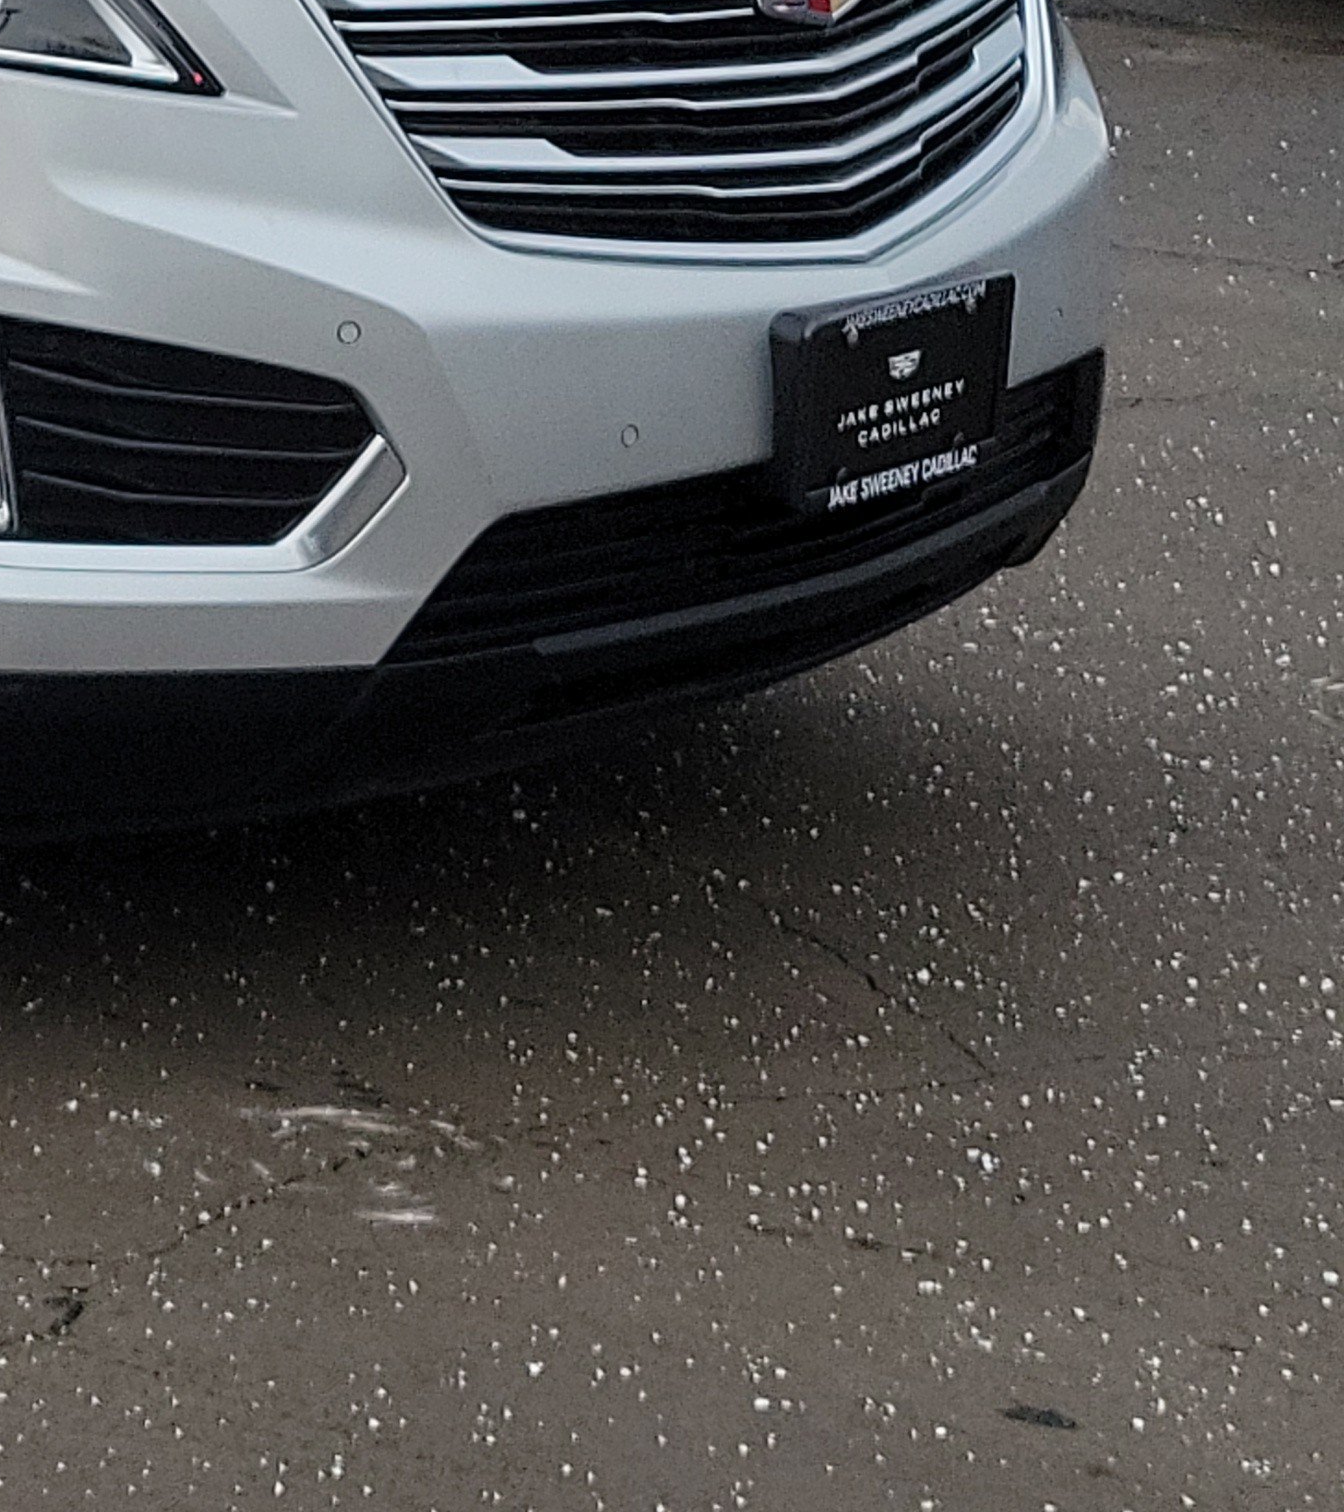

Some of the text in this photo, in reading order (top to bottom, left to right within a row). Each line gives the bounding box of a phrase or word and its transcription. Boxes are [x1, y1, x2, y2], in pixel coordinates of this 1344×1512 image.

[837, 378, 965, 433] JAKE SWEENEY
[858, 408, 941, 448] CADILLAC
[827, 444, 979, 511] JAKE SWEENEY CADILLAC
